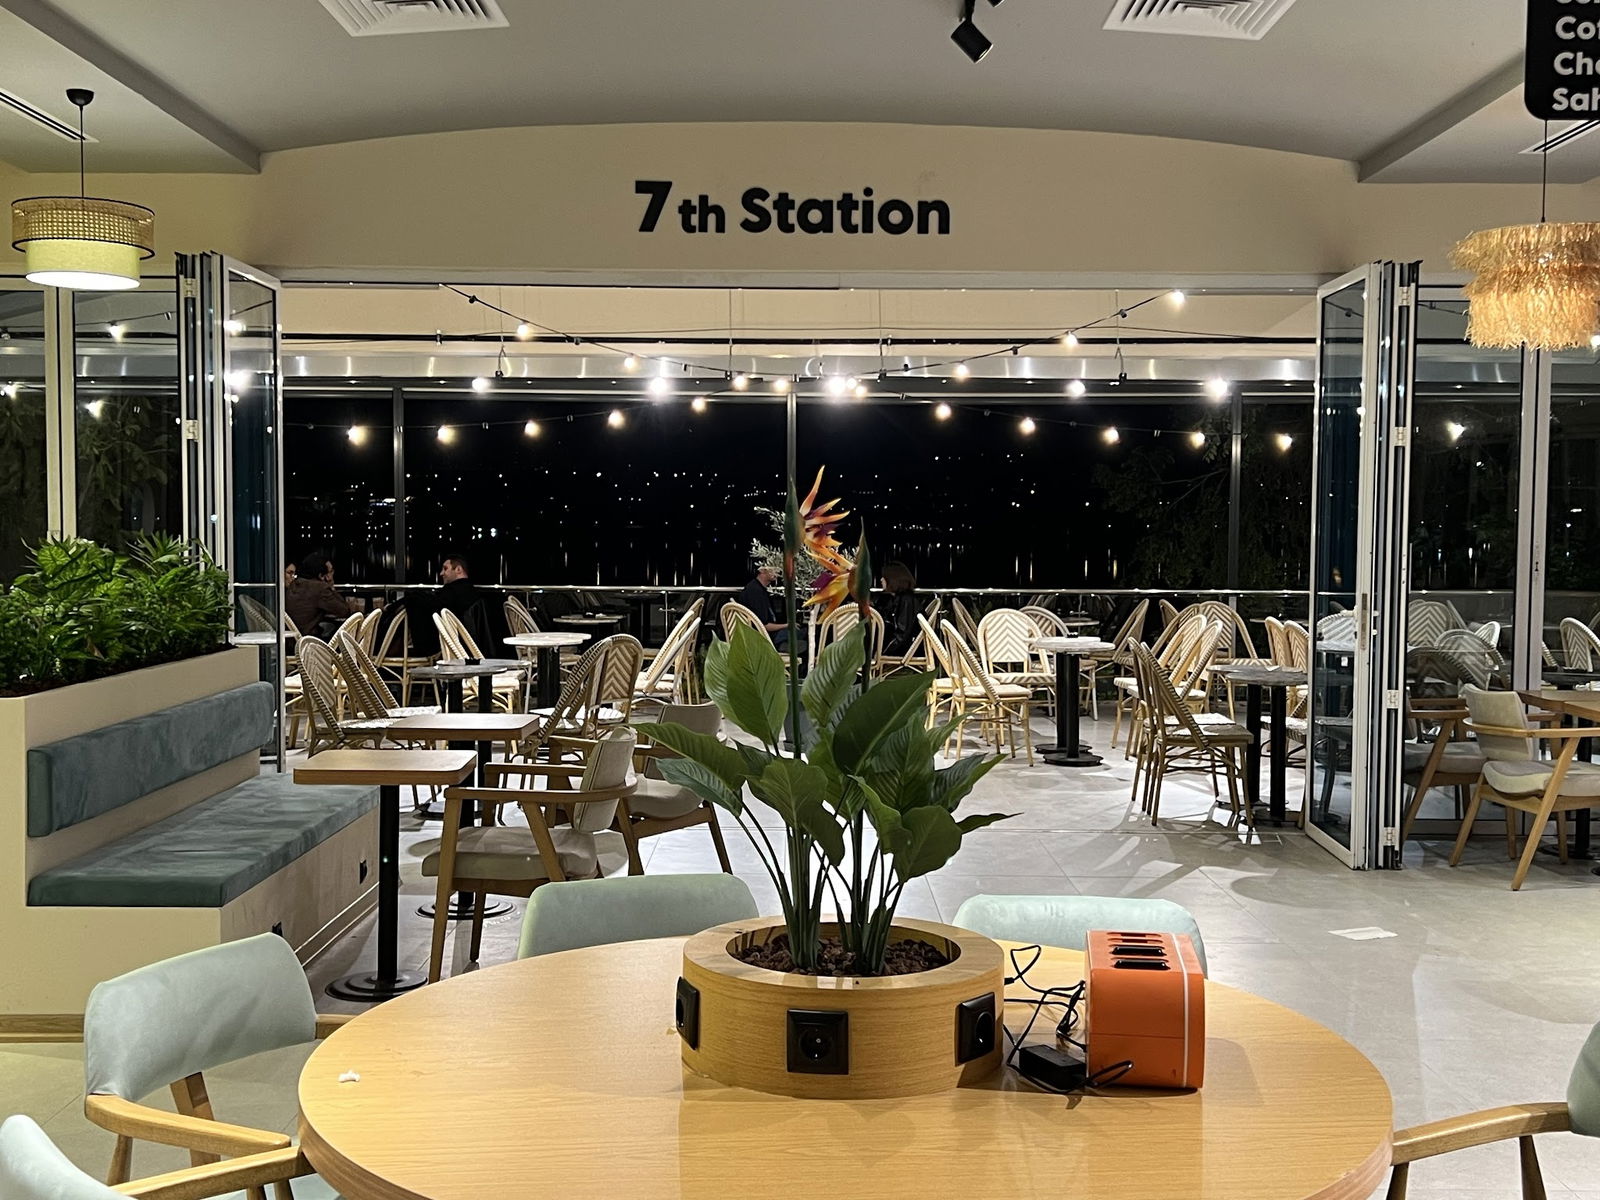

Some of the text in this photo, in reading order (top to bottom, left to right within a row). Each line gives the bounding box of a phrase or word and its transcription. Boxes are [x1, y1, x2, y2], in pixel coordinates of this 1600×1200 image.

[1555, 15, 1600, 40] Co
[1553, 51, 1600, 76] Ch
[739, 186, 951, 235] Station
